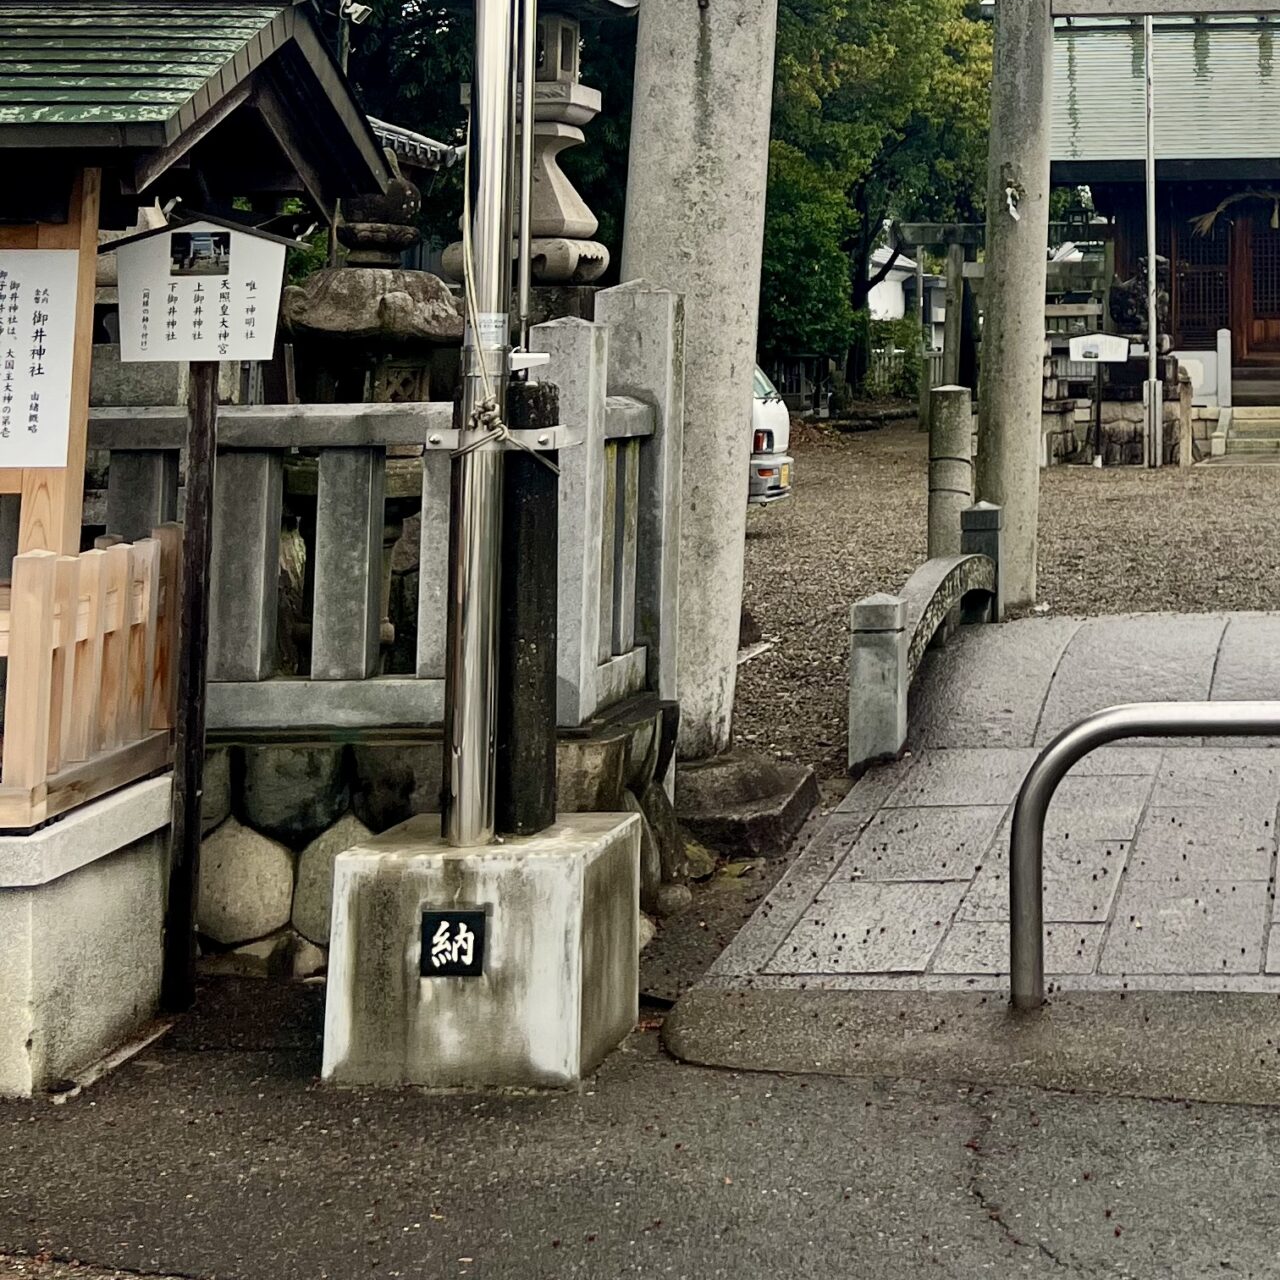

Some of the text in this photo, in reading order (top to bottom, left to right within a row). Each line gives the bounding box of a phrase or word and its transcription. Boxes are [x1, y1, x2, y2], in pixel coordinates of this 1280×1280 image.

[165, 282, 179, 341] 下御井神社
[192, 282, 205, 340] 上御井神社
[218, 279, 231, 355] 天照皇大神宮
[29, 310, 48, 377] 御井神社
[431, 920, 475, 968] 納
